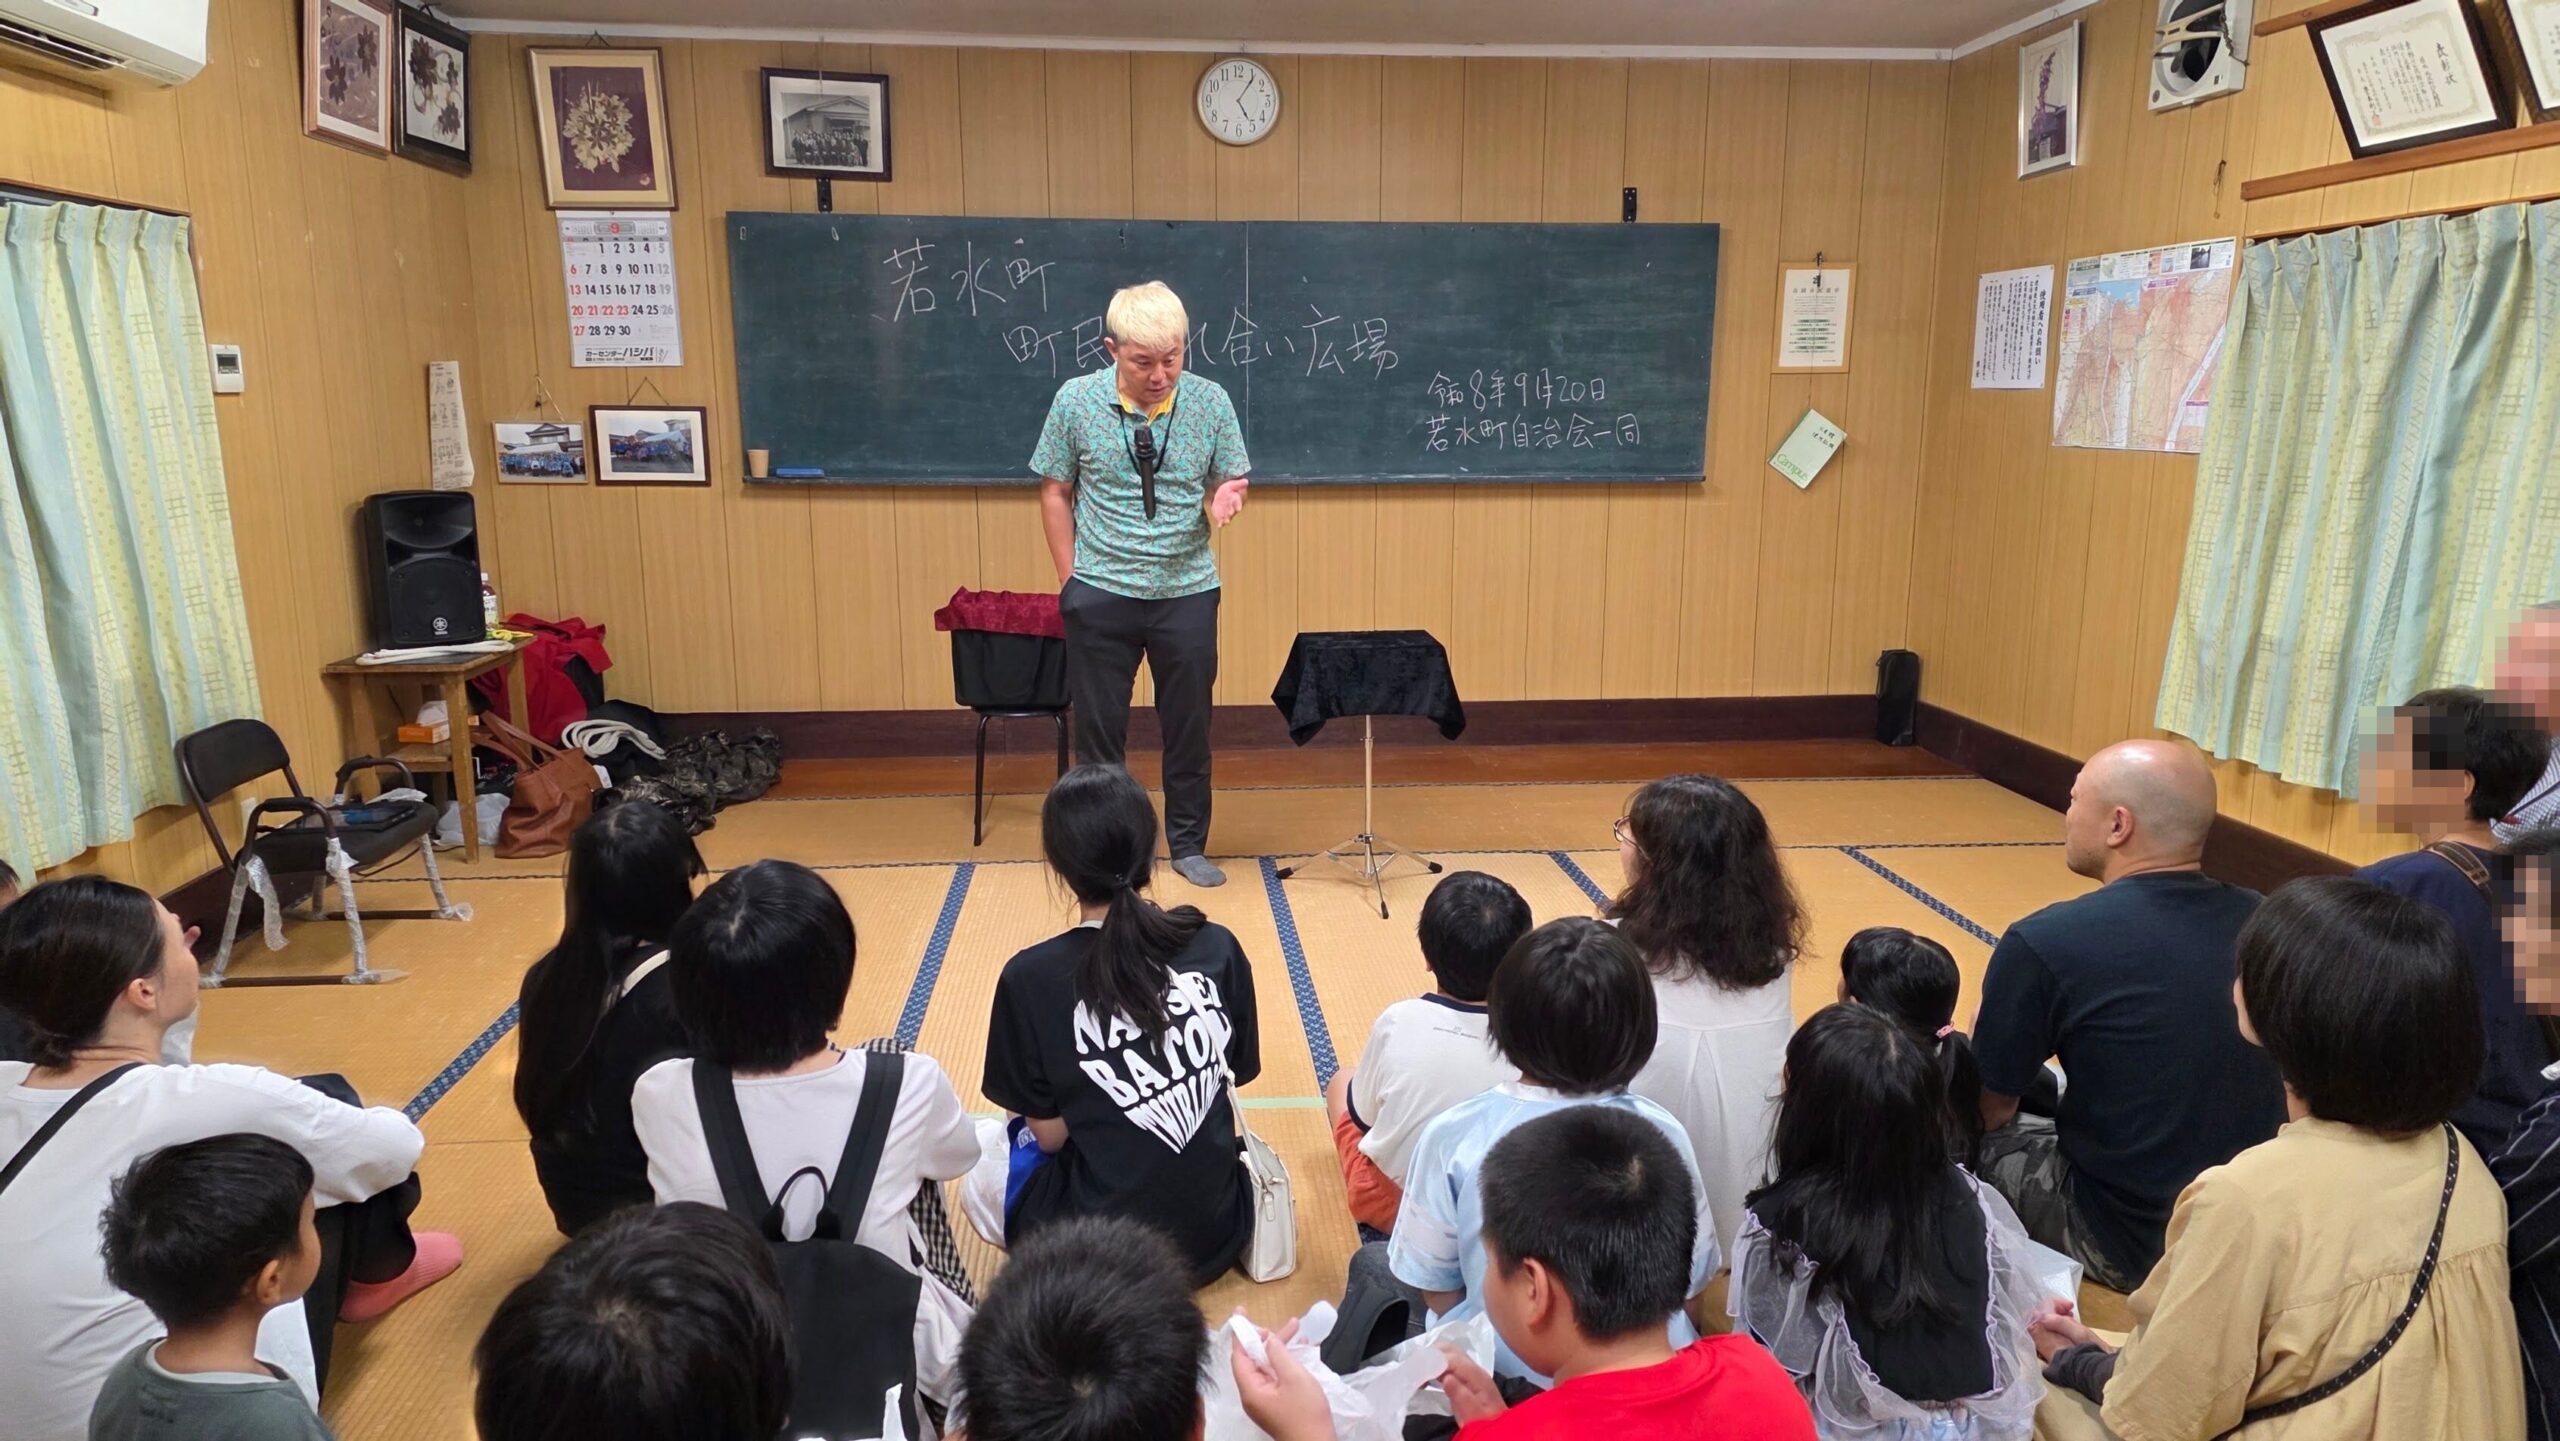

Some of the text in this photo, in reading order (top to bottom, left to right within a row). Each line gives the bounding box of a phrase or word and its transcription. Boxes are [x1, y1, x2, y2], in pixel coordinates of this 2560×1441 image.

[1221, 68, 1229, 81] 11
[1233, 64, 1244, 78] 12
[1209, 78, 1265, 93] 10 2
[1205, 94, 1271, 108] 9 3
[1211, 109, 1266, 123] 8 4
[1222, 119, 1256, 137] 7 6 5
[609, 222, 621, 235] 9
[599, 243, 604, 254] 1
[613, 243, 620, 254] 2
[629, 243, 636, 254] 3
[643, 243, 650, 254] 4
[658, 243, 665, 254] 5
[570, 264, 670, 275] 6 7 8 9 10 11 12
[883, 238, 1056, 323] 若水町
[570, 284, 671, 295] 13 14 15 16 17 18 19
[571, 304, 674, 316] 20 21 22 23 24 25 26
[573, 325, 631, 336] 27 28 29 30
[1002, 303, 1399, 380] 町民れ合い広場
[1425, 412, 1641, 452] 若水町自治会一同
[1776, 453, 1809, 481] Campus
[1073, 971, 1223, 1055] NASEI
